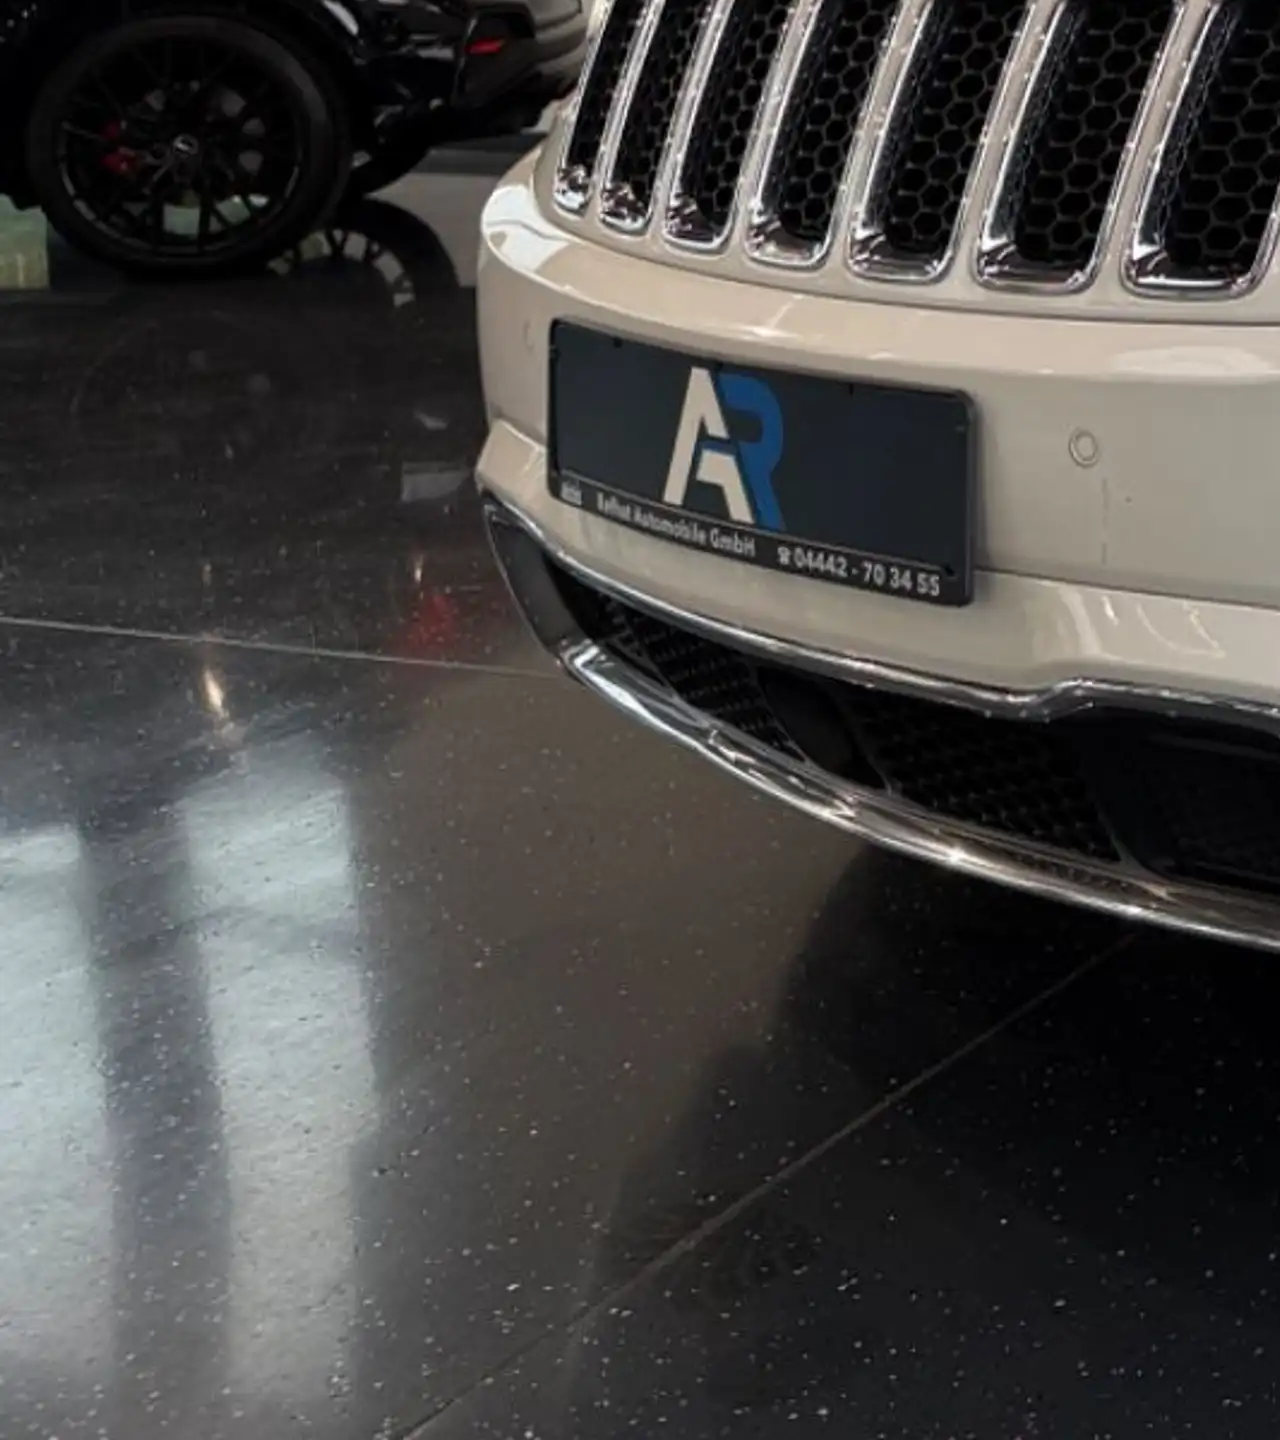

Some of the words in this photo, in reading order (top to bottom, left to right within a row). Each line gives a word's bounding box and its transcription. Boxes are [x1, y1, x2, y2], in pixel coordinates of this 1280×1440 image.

[663, 366, 786, 531] AR
[709, 527, 756, 558] GmbH
[793, 547, 848, 578] 04442
[861, 561, 886, 587] 70
[889, 567, 912, 592] 34
[916, 571, 940, 597] 55
